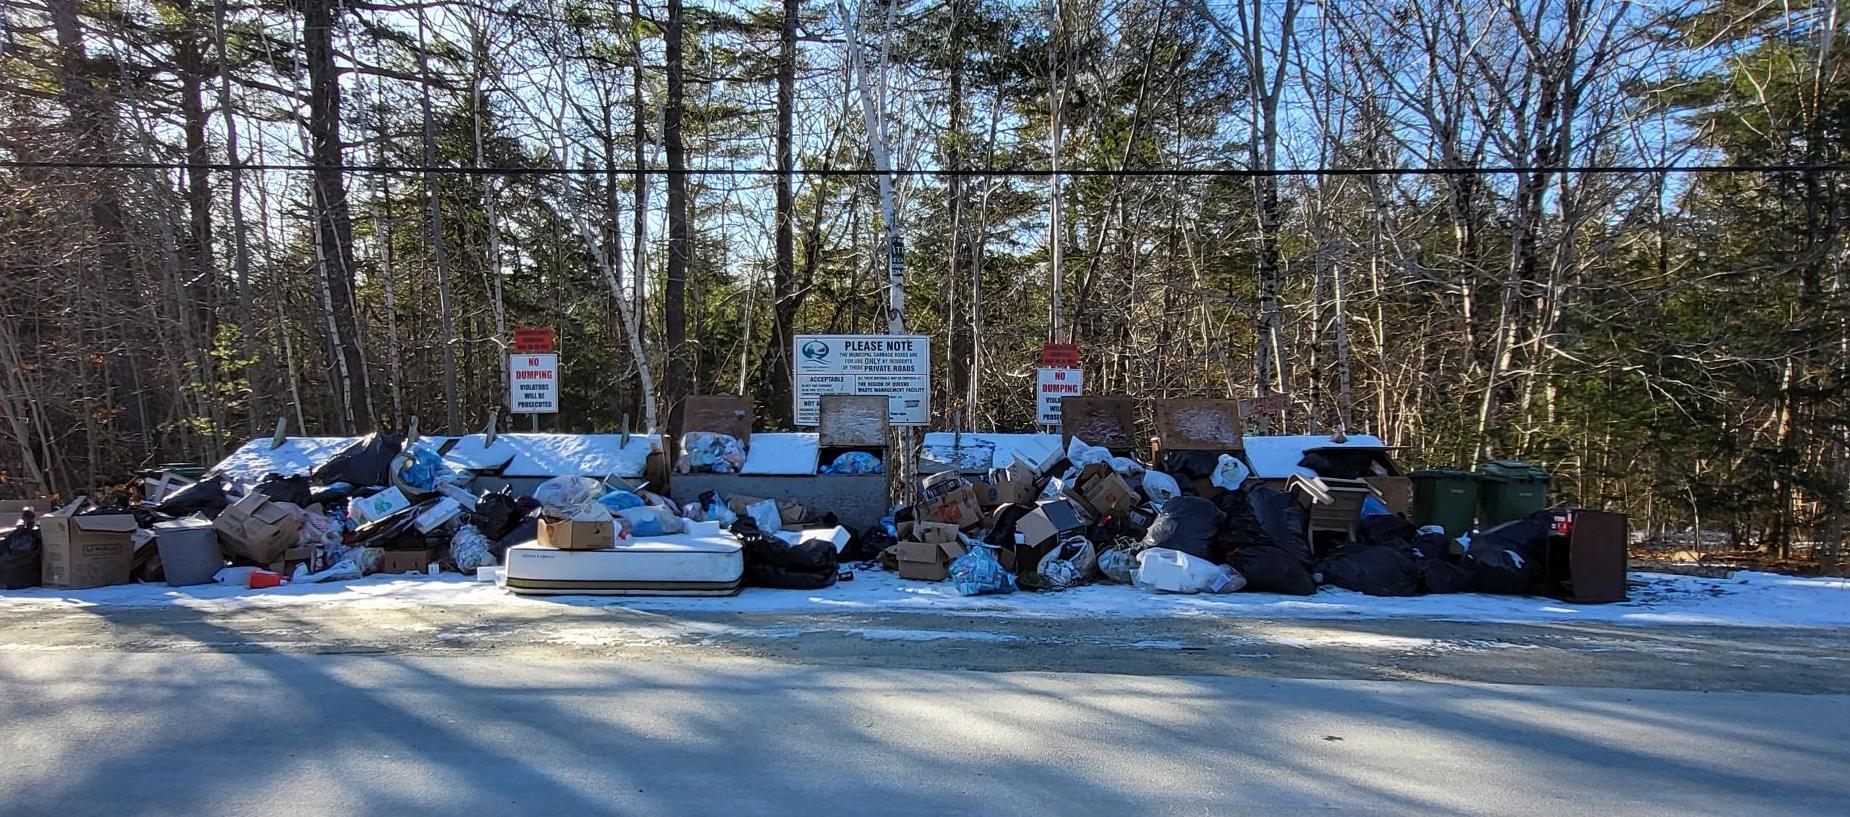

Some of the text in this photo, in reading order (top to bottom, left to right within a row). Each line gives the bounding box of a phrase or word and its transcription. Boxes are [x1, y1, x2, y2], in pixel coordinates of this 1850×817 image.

[844, 340, 913, 351] PLEASE NOTE
[528, 357, 540, 367] NO
[516, 370, 552, 380] DUMPING
[1054, 372, 1066, 380] NO
[1042, 384, 1078, 393] DUMPING
